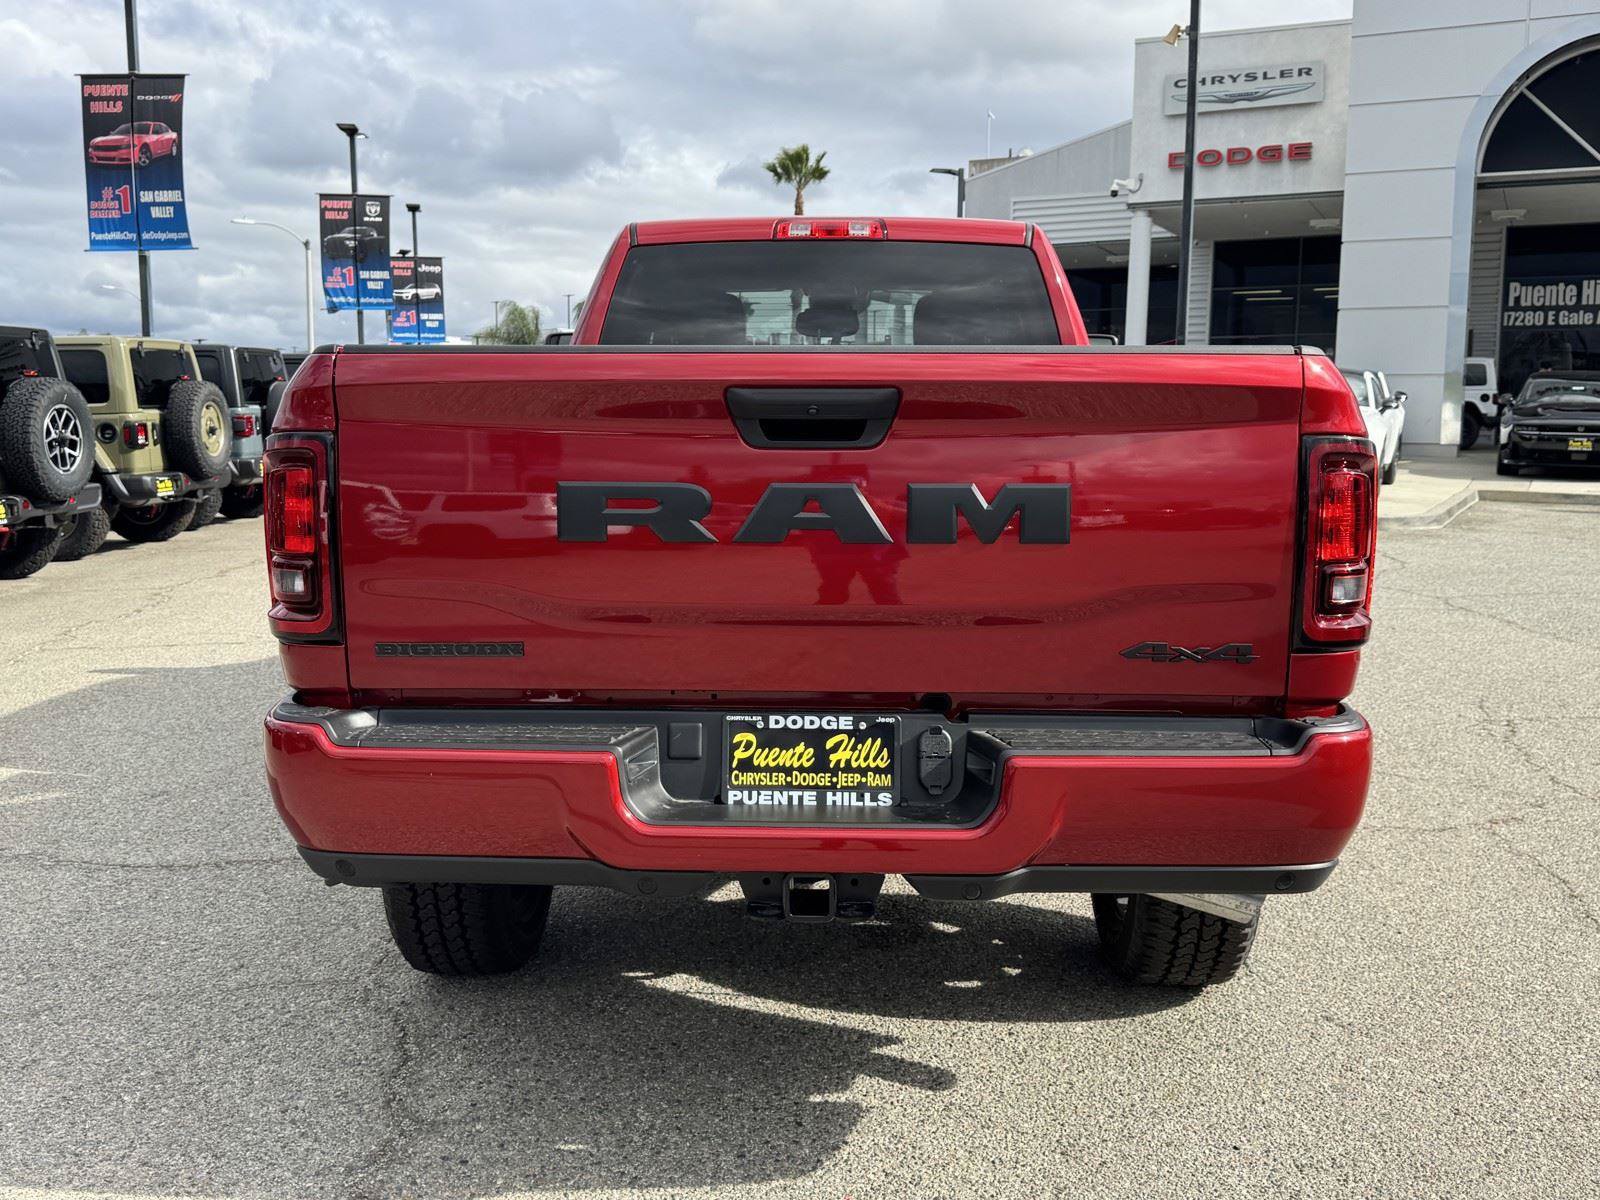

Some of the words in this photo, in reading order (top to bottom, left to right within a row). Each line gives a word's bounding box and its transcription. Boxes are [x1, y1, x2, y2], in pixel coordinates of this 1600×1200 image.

[1173, 67, 1313, 88] CHRYSLER
[83, 85, 129, 97] PUENTE
[90, 100, 123, 113] HILLS
[1168, 142, 1313, 169] DODGE
[139, 190, 154, 202] SAN
[155, 190, 183, 202] GABRIEL
[150, 206, 175, 218] VALLEY
[418, 264, 442, 273] Jeep
[1508, 282, 1578, 307] Puente
[1503, 310, 1544, 327] 17280
[1547, 310, 1557, 326] E
[1559, 309, 1594, 326] Gale
[556, 481, 1072, 545] RAM
[375, 641, 525, 657] BIGHORN
[769, 715, 853, 730] DODGE
[732, 732, 815, 769] Puente
[825, 733, 891, 769] Hills
[727, 790, 817, 806] PUENTE
[826, 791, 893, 807] HILLS
